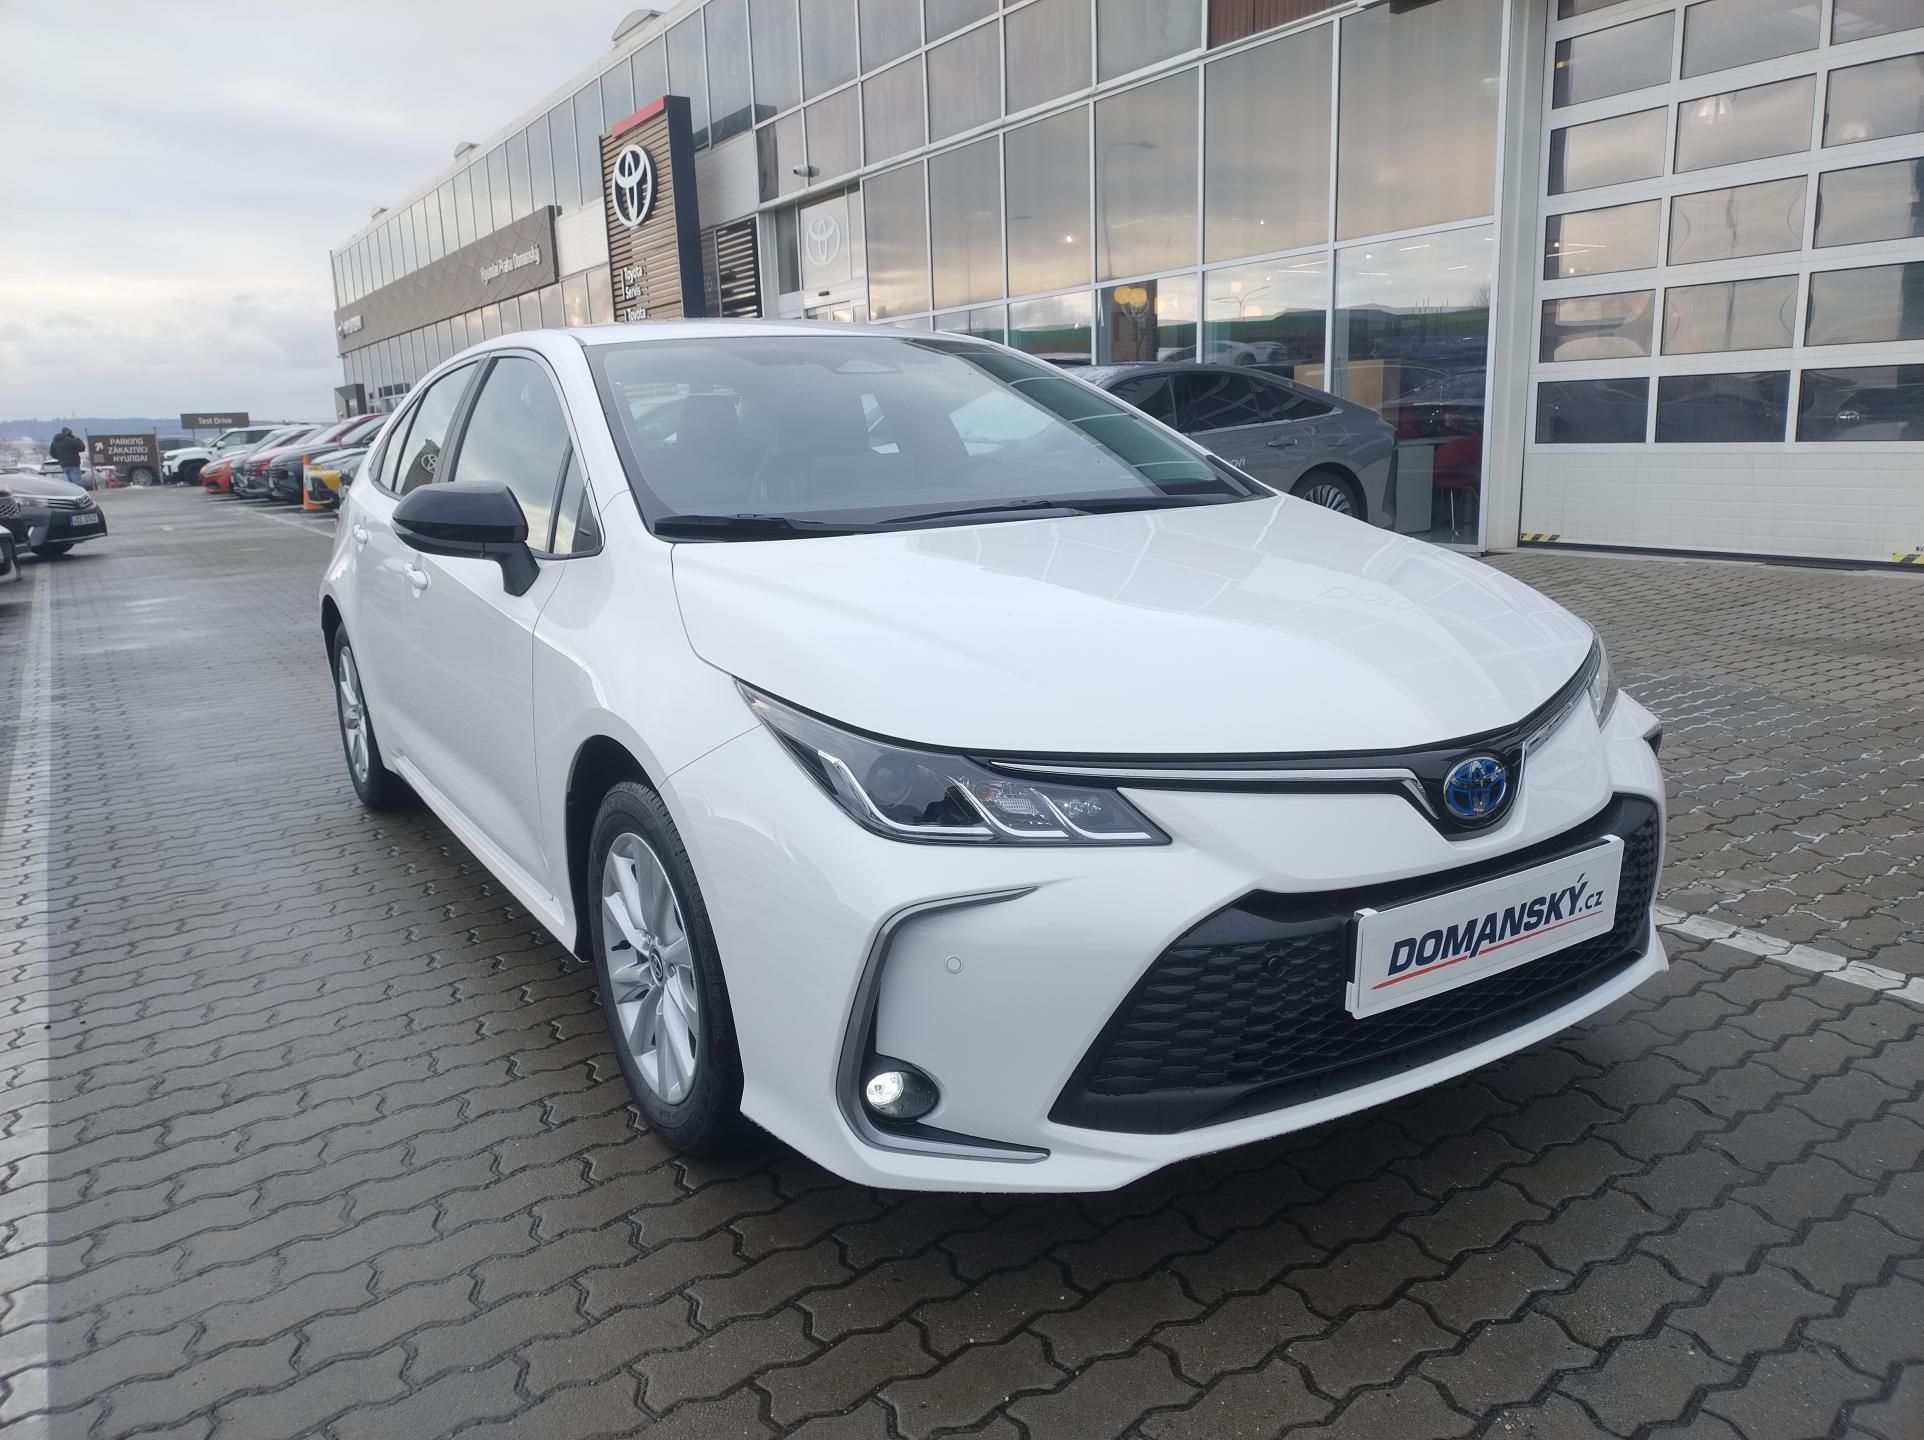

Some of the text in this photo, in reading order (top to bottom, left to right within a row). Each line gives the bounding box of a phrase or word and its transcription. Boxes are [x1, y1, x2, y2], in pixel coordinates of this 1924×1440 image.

[623, 266, 643, 283] Toyota
[625, 284, 641, 300] Servis
[627, 307, 646, 320] Toyota
[198, 416, 232, 425] Test Drive
[110, 437, 143, 446] PARKING
[113, 454, 148, 463] HYUNDAI
